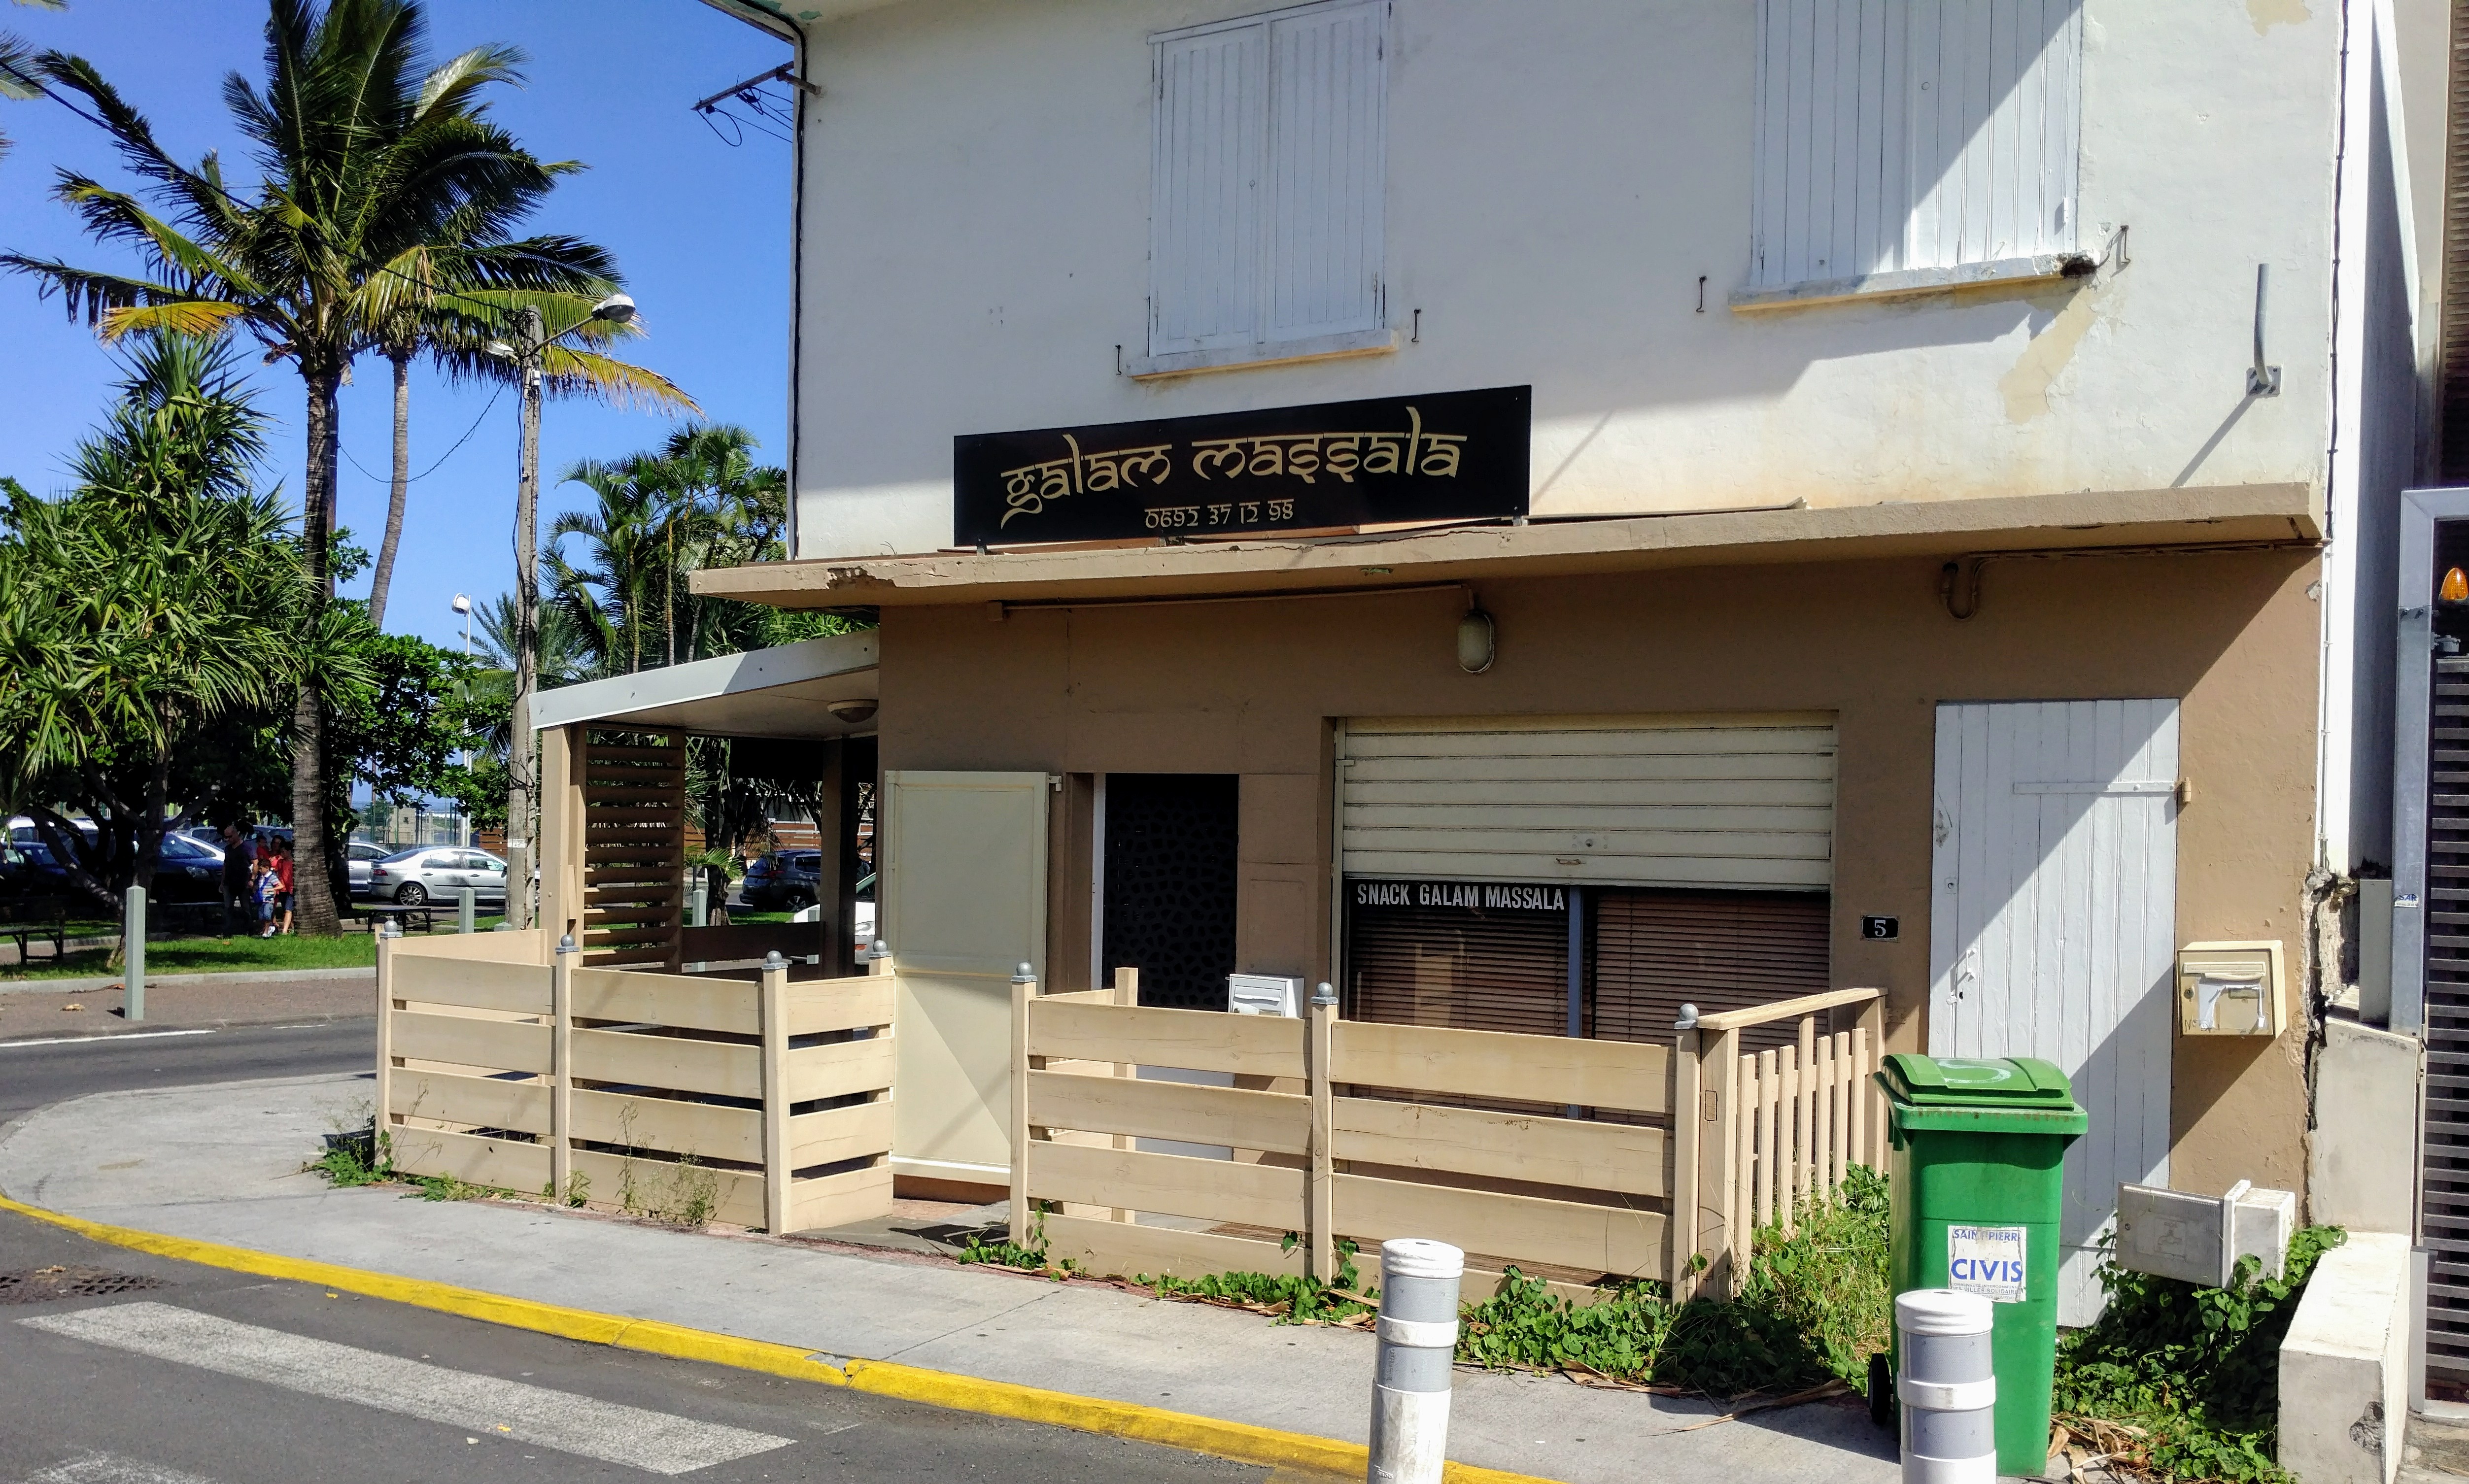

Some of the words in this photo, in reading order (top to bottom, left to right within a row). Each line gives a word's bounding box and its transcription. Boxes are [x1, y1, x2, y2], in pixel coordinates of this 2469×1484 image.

[1001, 434, 1172, 530] galam
[1192, 406, 1468, 484] massala
[1144, 506, 1200, 528] 0692
[1207, 504, 1232, 525] 37
[1239, 502, 1260, 524] 12
[1268, 499, 1294, 520] 98
[1358, 884, 1410, 905] SNACK
[1419, 884, 1478, 907] GALAM
[1486, 886, 1565, 910] MASSALA
[1874, 919, 1886, 937] 5
[1952, 1258, 2023, 1282] CIVIS
